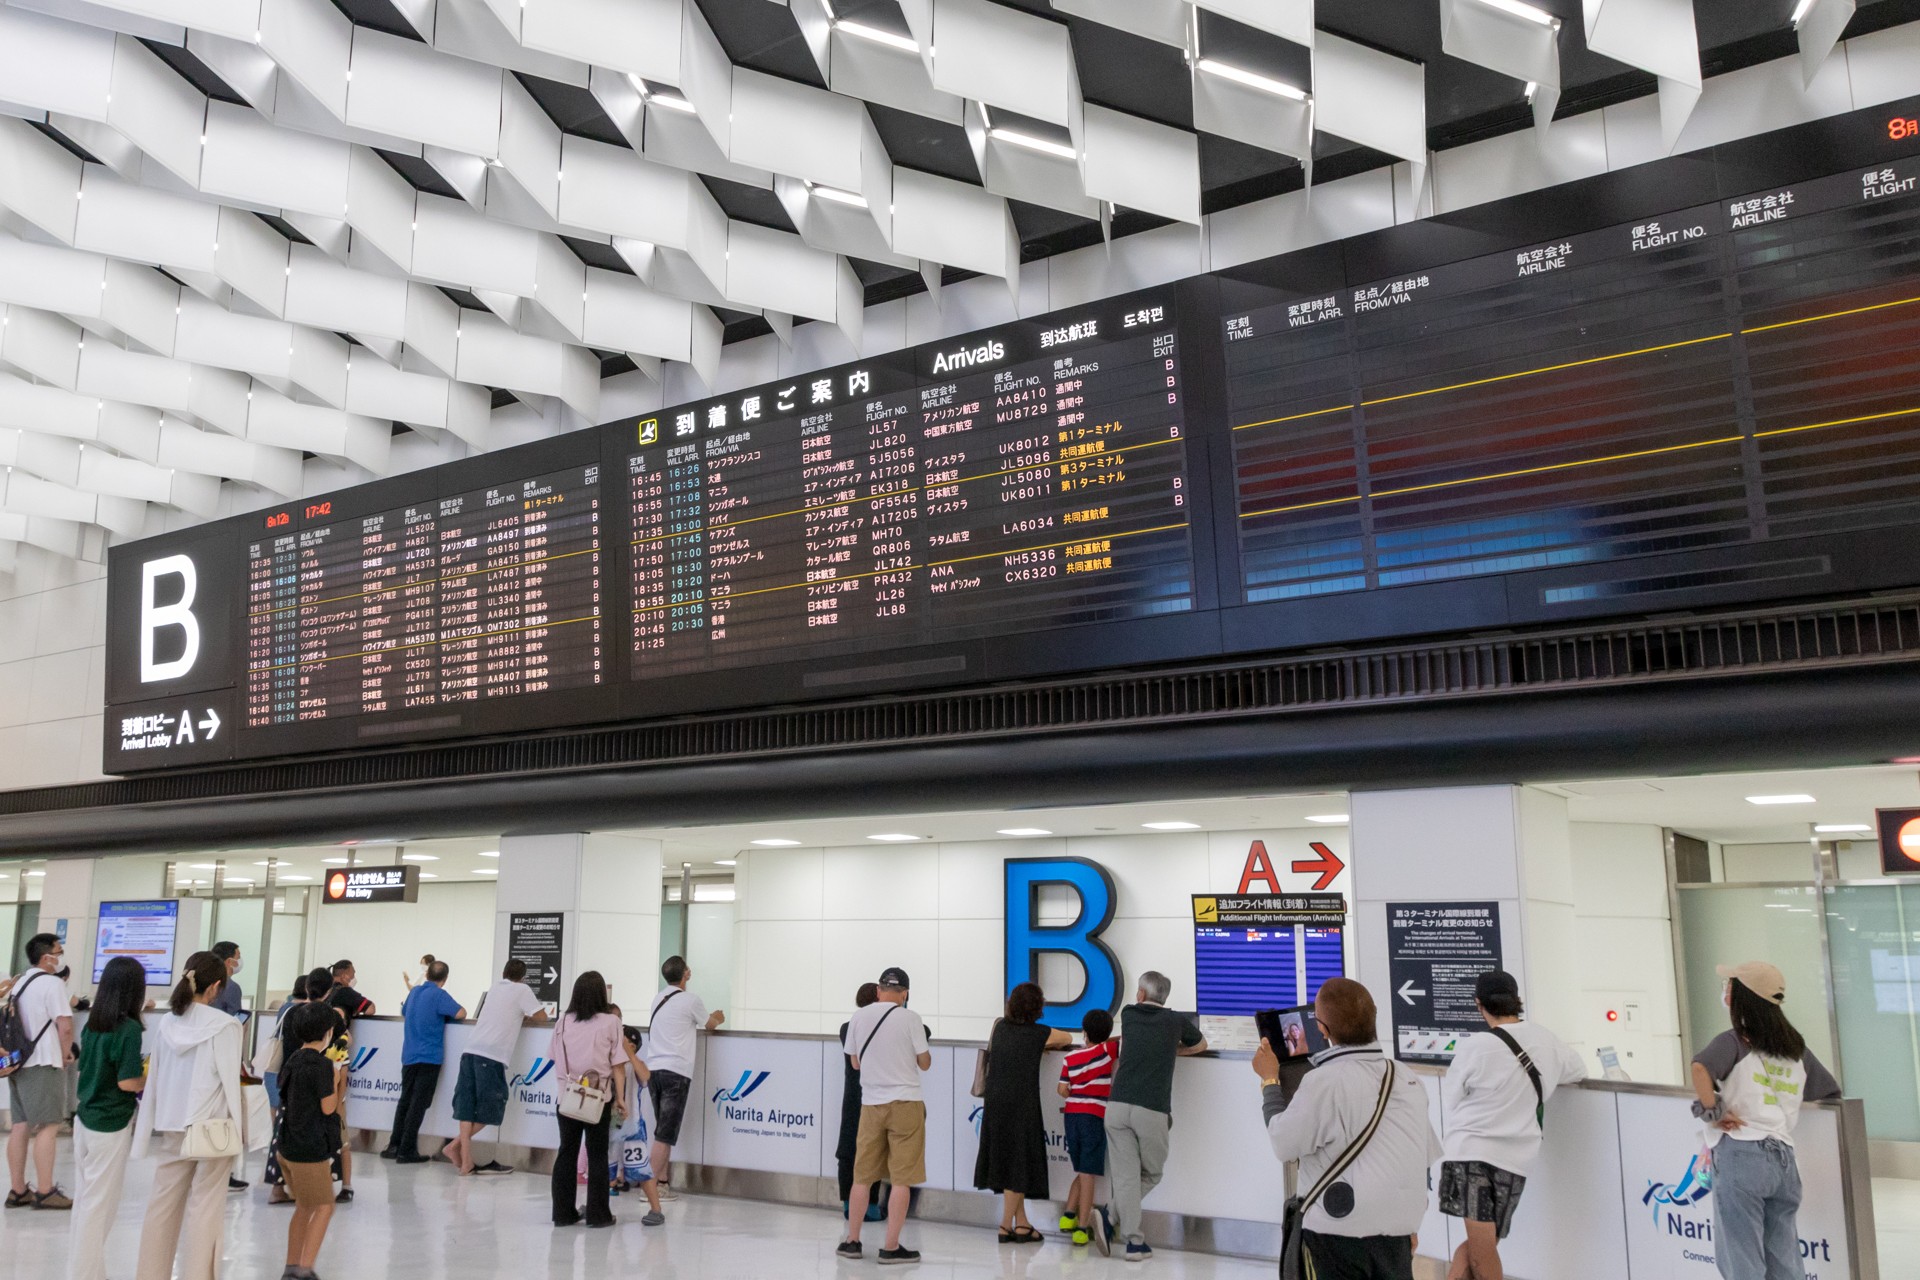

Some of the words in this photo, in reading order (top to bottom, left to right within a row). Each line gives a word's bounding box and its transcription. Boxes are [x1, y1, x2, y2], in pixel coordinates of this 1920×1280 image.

[1888, 118, 1919, 140] 8月
[1862, 168, 1895, 186] 便名
[1863, 177, 1916, 199] FLIGHT
[1730, 191, 1794, 216] 航空会社
[1732, 206, 1786, 228] AIRLINE
[1631, 222, 1661, 240] 便名
[1632, 231, 1679, 251] FLIGHT
[1683, 226, 1707, 238] NO.
[1516, 243, 1572, 265] 航空会社
[1518, 257, 1565, 277] AIRLINE
[1288, 296, 1336, 317] 変更時刻
[1354, 293, 1411, 313] FROM/VIA
[1124, 306, 1164, 328] 도착편
[1226, 316, 1249, 331] 定刻
[1289, 313, 1314, 328] WILL
[1318, 307, 1343, 322] ARR.
[1040, 320, 1097, 348] 到达航班
[1153, 334, 1174, 348] 出口
[1228, 327, 1254, 341] TIME
[933, 340, 1004, 374] Arrivals
[1154, 345, 1174, 358] EXIT
[1054, 357, 1073, 371] 備考
[1054, 363, 1099, 380] REMARKS
[994, 372, 1013, 384] 便名
[994, 379, 1023, 393] FLIGHT
[1026, 375, 1041, 385] NO.
[922, 384, 957, 400] 航空会社
[922, 396, 952, 410] AIRLINE
[801, 412, 833, 428] 航空会社
[866, 409, 892, 422] FLIGHT
[895, 406, 908, 415] NO.
[632, 472, 661, 486] 16:45
[669, 464, 699, 478] 16:26
[707, 451, 761, 469] サンフランシスコ
[802, 435, 831, 450] 日本航空
[869, 420, 897, 435] JL57
[923, 402, 980, 423] アメリカン航空
[996, 387, 1046, 408] AA8410
[1166, 360, 1174, 370] B
[801, 423, 828, 436] AIRLINE
[632, 486, 662, 500] 16:50
[669, 478, 700, 492] 16:53
[803, 449, 832, 464] 日本航空
[870, 434, 906, 450] JL820
[924, 419, 973, 438] 中国東方航空
[997, 403, 1047, 423] MU8729
[1167, 376, 1175, 387] B
[667, 444, 696, 458] 変更時刻
[706, 445, 739, 457] FROM/VIA
[630, 456, 644, 467] 定刻
[630, 464, 646, 474] TIME
[667, 456, 683, 466] WILL
[585, 476, 598, 485] EXIT
[633, 513, 662, 527] 17:30
[670, 506, 700, 520] 17:32
[708, 496, 749, 512] シンガポール
[870, 463, 915, 480] AI7206
[925, 453, 965, 469] ヴィスタラ
[999, 435, 1049, 454] UK8012
[524, 486, 552, 498] REMARKS
[305, 502, 331, 518] 17:42
[486, 497, 504, 507] FLIGHT
[440, 508, 460, 517] AIRLINE
[634, 541, 663, 554] 17:40
[671, 533, 701, 547] 17:45
[709, 526, 736, 540] ケアンズ
[805, 506, 849, 523] カンタス航空
[871, 493, 917, 510] QF5545
[926, 485, 959, 500] 日本航空
[1001, 468, 1051, 486] JL5080
[251, 570, 271, 580] 16:00
[276, 564, 296, 574] 16:15
[406, 535, 429, 548] HA821
[441, 529, 462, 540] 日本航空
[488, 517, 519, 530] JL6405
[634, 582, 664, 596] 18:35
[672, 576, 702, 589] 19:20
[710, 572, 730, 583] ドーハ
[806, 550, 850, 567] カタール航空
[873, 541, 911, 556] QR806
[929, 531, 970, 546] ラタム航空
[1003, 516, 1054, 535] LA6034
[1063, 507, 1109, 525] 共同運航便
[141, 554, 199, 683] B
[121, 713, 175, 736] 到着ロビー
[175, 710, 194, 744] A
[121, 736, 146, 750] Arrival
[147, 733, 172, 748] Lobby
[1237, 840, 1282, 894] A
[346, 888, 355, 898] No
[356, 888, 372, 899] Entry
[1254, 914, 1272, 923] Flight
[1312, 914, 1342, 922] (Arrivals)
[1004, 856, 1124, 1032] B
[346, 1076, 372, 1089] Narita
[520, 1090, 551, 1104] Narita
[726, 1106, 763, 1122] Narita
[768, 1109, 814, 1128] Airport
[733, 1127, 760, 1136] Connecting
[761, 1129, 775, 1137] Japan
[624, 1148, 642, 1162] 23
[1667, 1212, 1712, 1242] Nari
[1683, 1250, 1715, 1264] Connec
